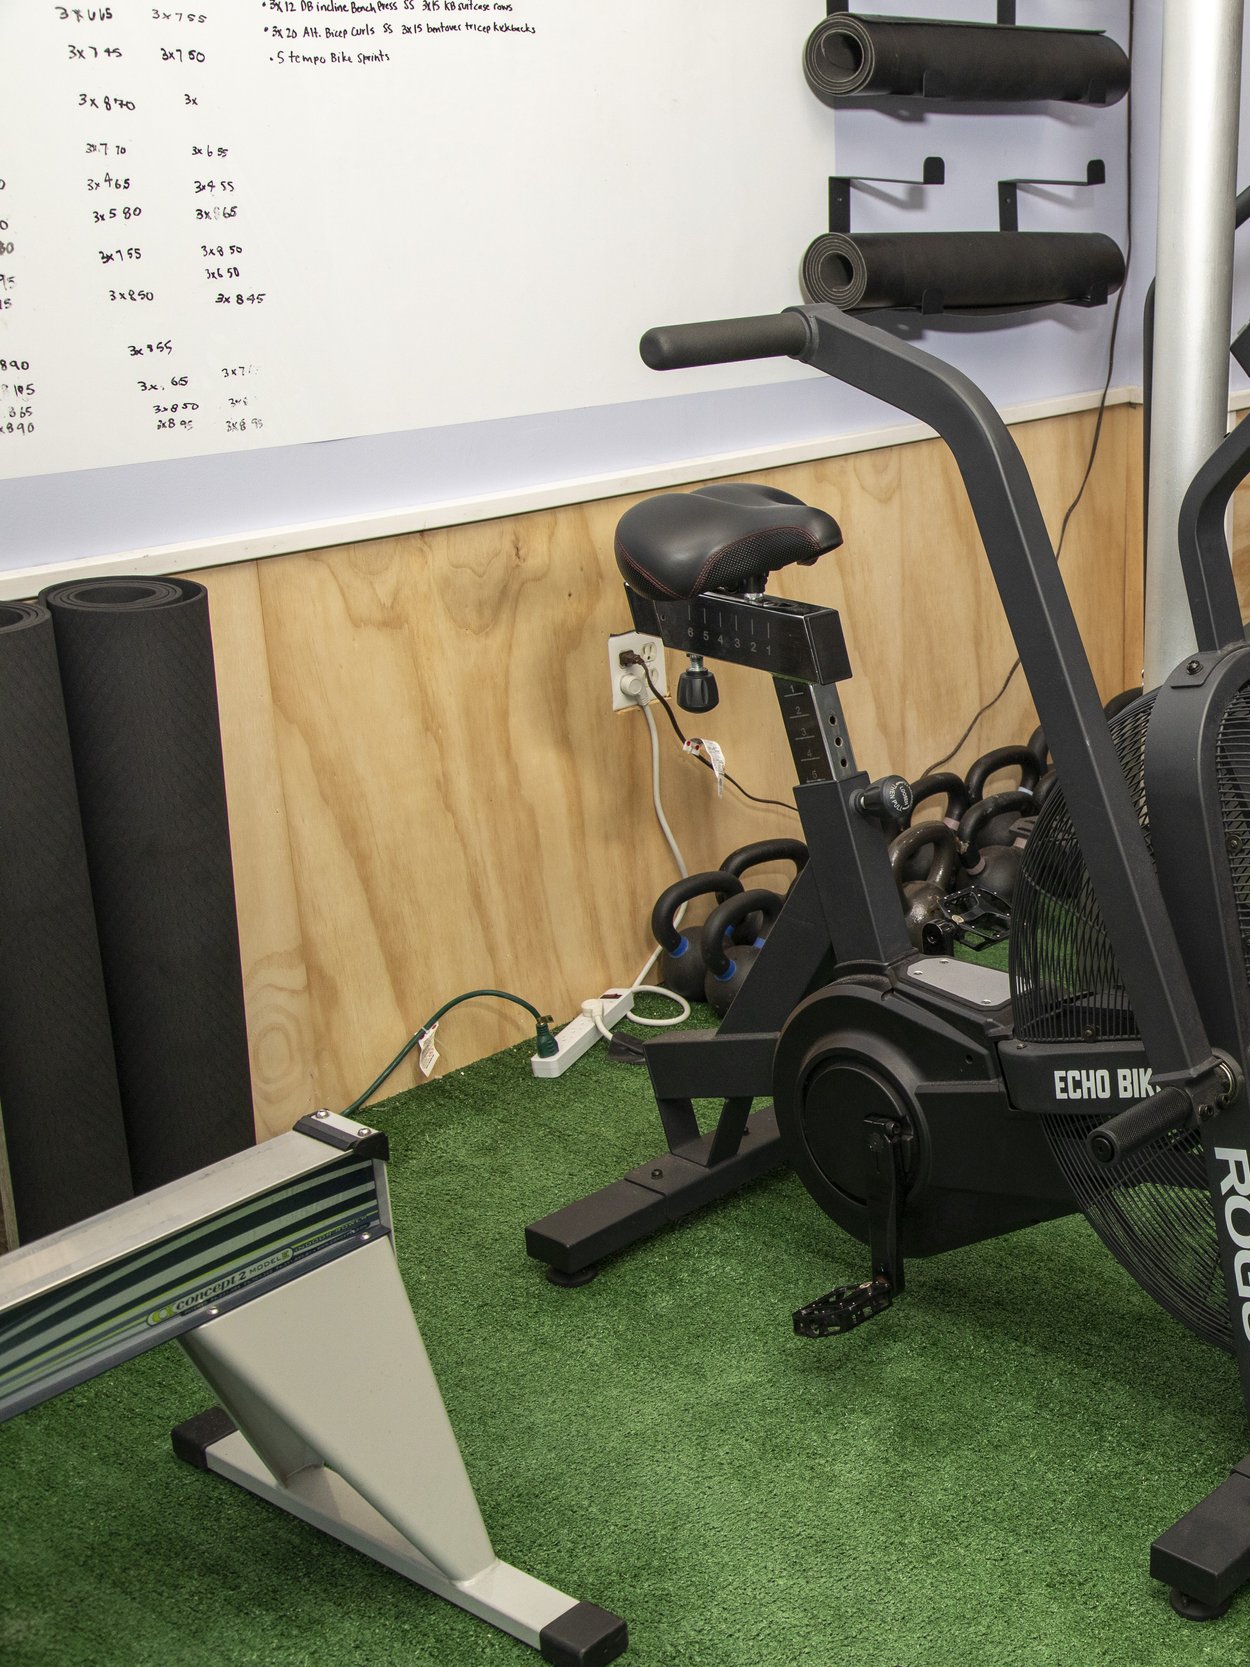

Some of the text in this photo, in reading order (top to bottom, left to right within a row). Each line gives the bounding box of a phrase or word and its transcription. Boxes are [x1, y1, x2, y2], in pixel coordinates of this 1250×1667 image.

[301, 1, 313, 11] DB
[317, 0, 349, 12] incline
[351, 2, 376, 13] Bench
[378, 1, 397, 11] Press
[445, 0, 456, 11] KB
[458, 0, 490, 11] suitcase
[494, 3, 513, 11] rows
[303, 26, 321, 38] Alt.
[325, 27, 347, 38] Bicep
[351, 24, 375, 36] Curls
[465, 22, 491, 34] tricep
[494, 22, 536, 34] kickbacks
[289, 51, 326, 65] tempo
[331, 52, 352, 63] Bike
[688, 627, 771, 656] 6 5 4 3 2 1
[790, 684, 794, 693] 1
[795, 706, 801, 715] 2
[801, 728, 807, 736] 3
[812, 770, 818, 778] 5
[1054, 1068, 1161, 1100] ECHO BIK
[176, 1276, 238, 1310] concept
[239, 1271, 247, 1281] 2
[249, 1257, 281, 1275] MODEL
